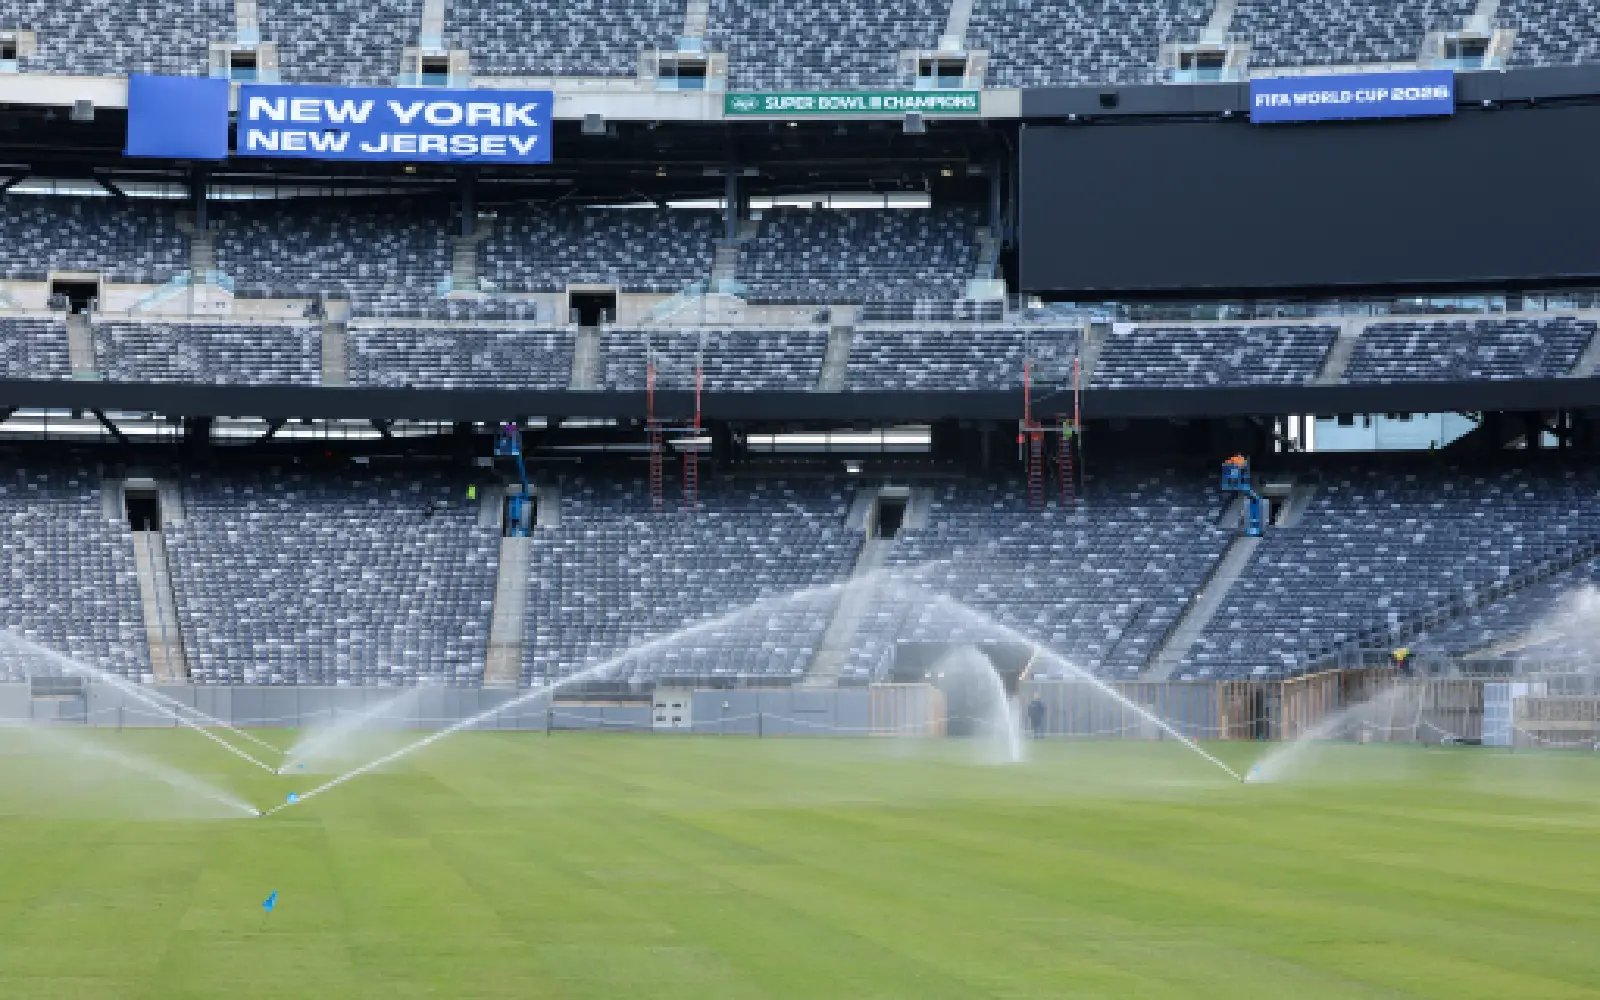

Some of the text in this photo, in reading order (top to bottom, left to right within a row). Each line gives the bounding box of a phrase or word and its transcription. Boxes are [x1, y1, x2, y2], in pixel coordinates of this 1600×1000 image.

[765, 96, 816, 110] SUPER
[818, 96, 867, 110] BOWL
[883, 95, 976, 109] CHAMPIONS
[1255, 85, 1450, 107] FIFA WORLD CUP 2026
[247, 97, 540, 126] NEW YORK
[247, 129, 538, 156] NEW JERSEY
